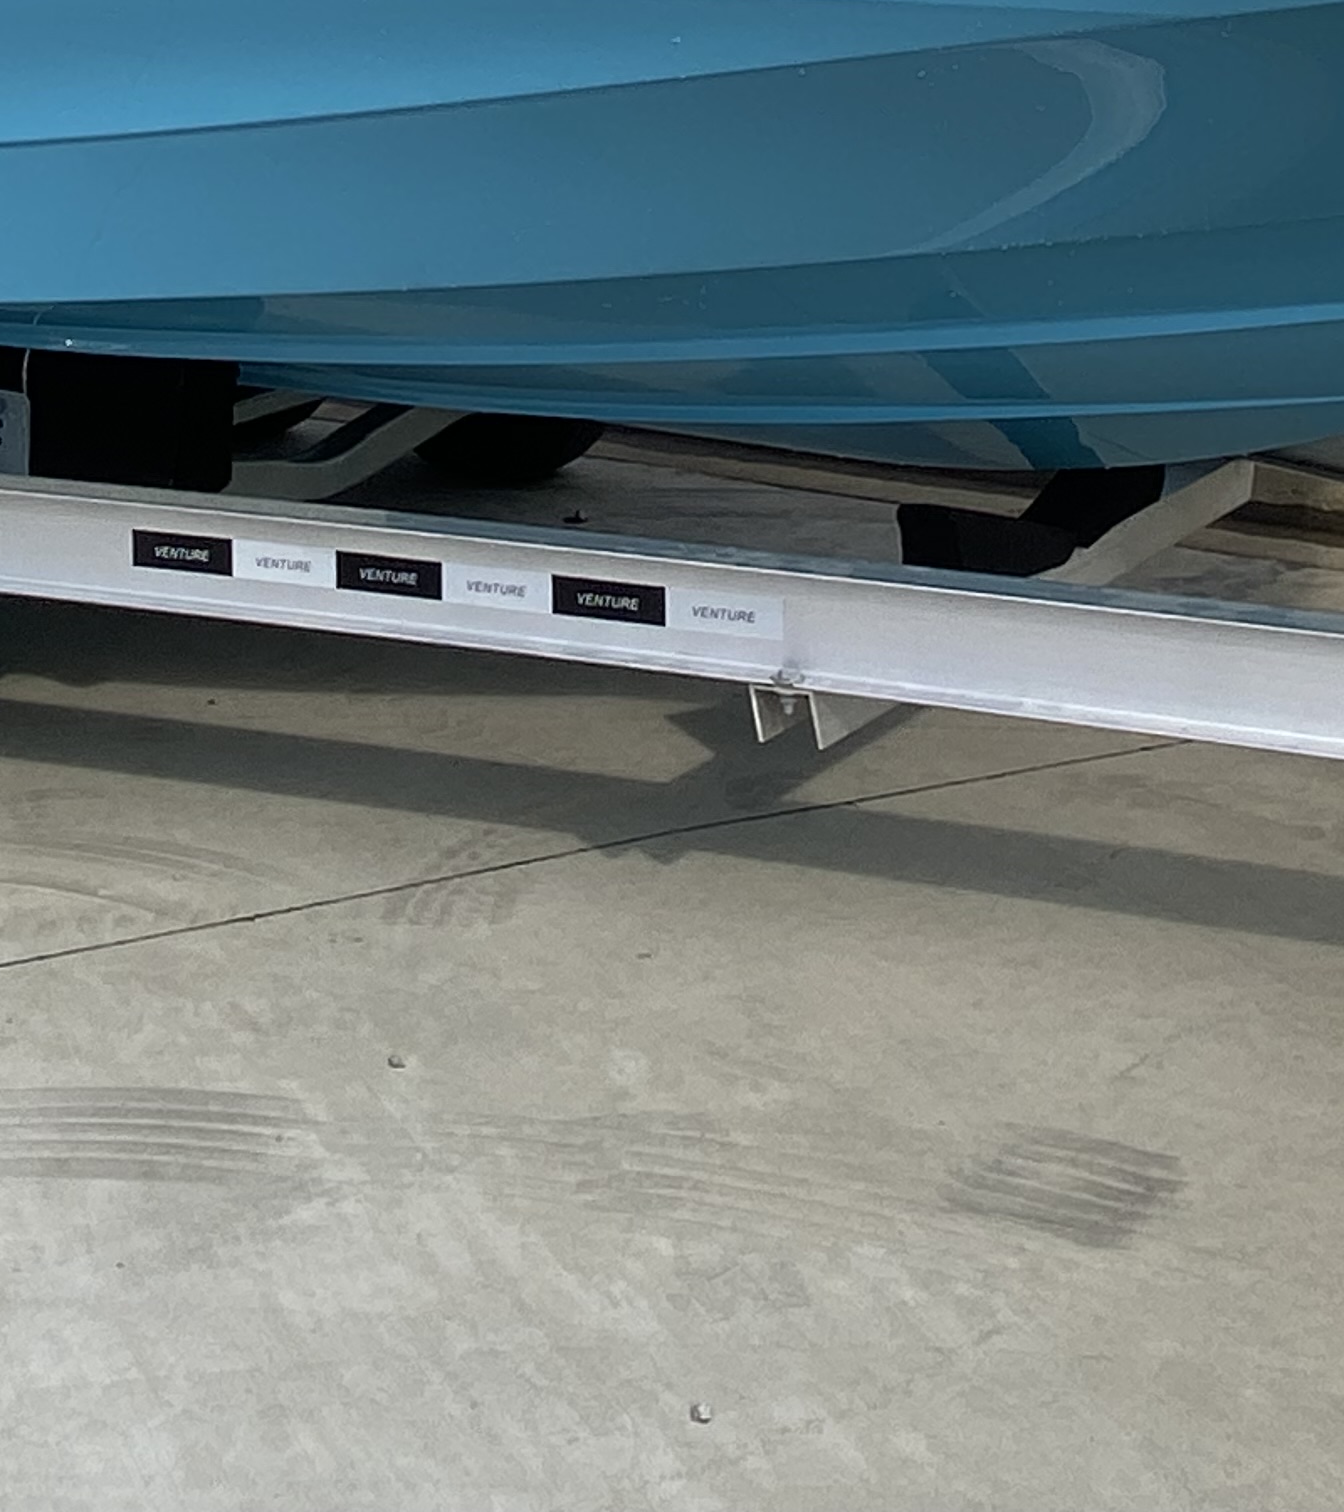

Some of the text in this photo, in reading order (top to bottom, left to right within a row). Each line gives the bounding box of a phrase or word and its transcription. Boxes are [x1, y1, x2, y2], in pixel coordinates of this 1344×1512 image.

[154, 545, 757, 623] VENTURE VENTURE VENTURE VENTURE VENTURE VENTURE
